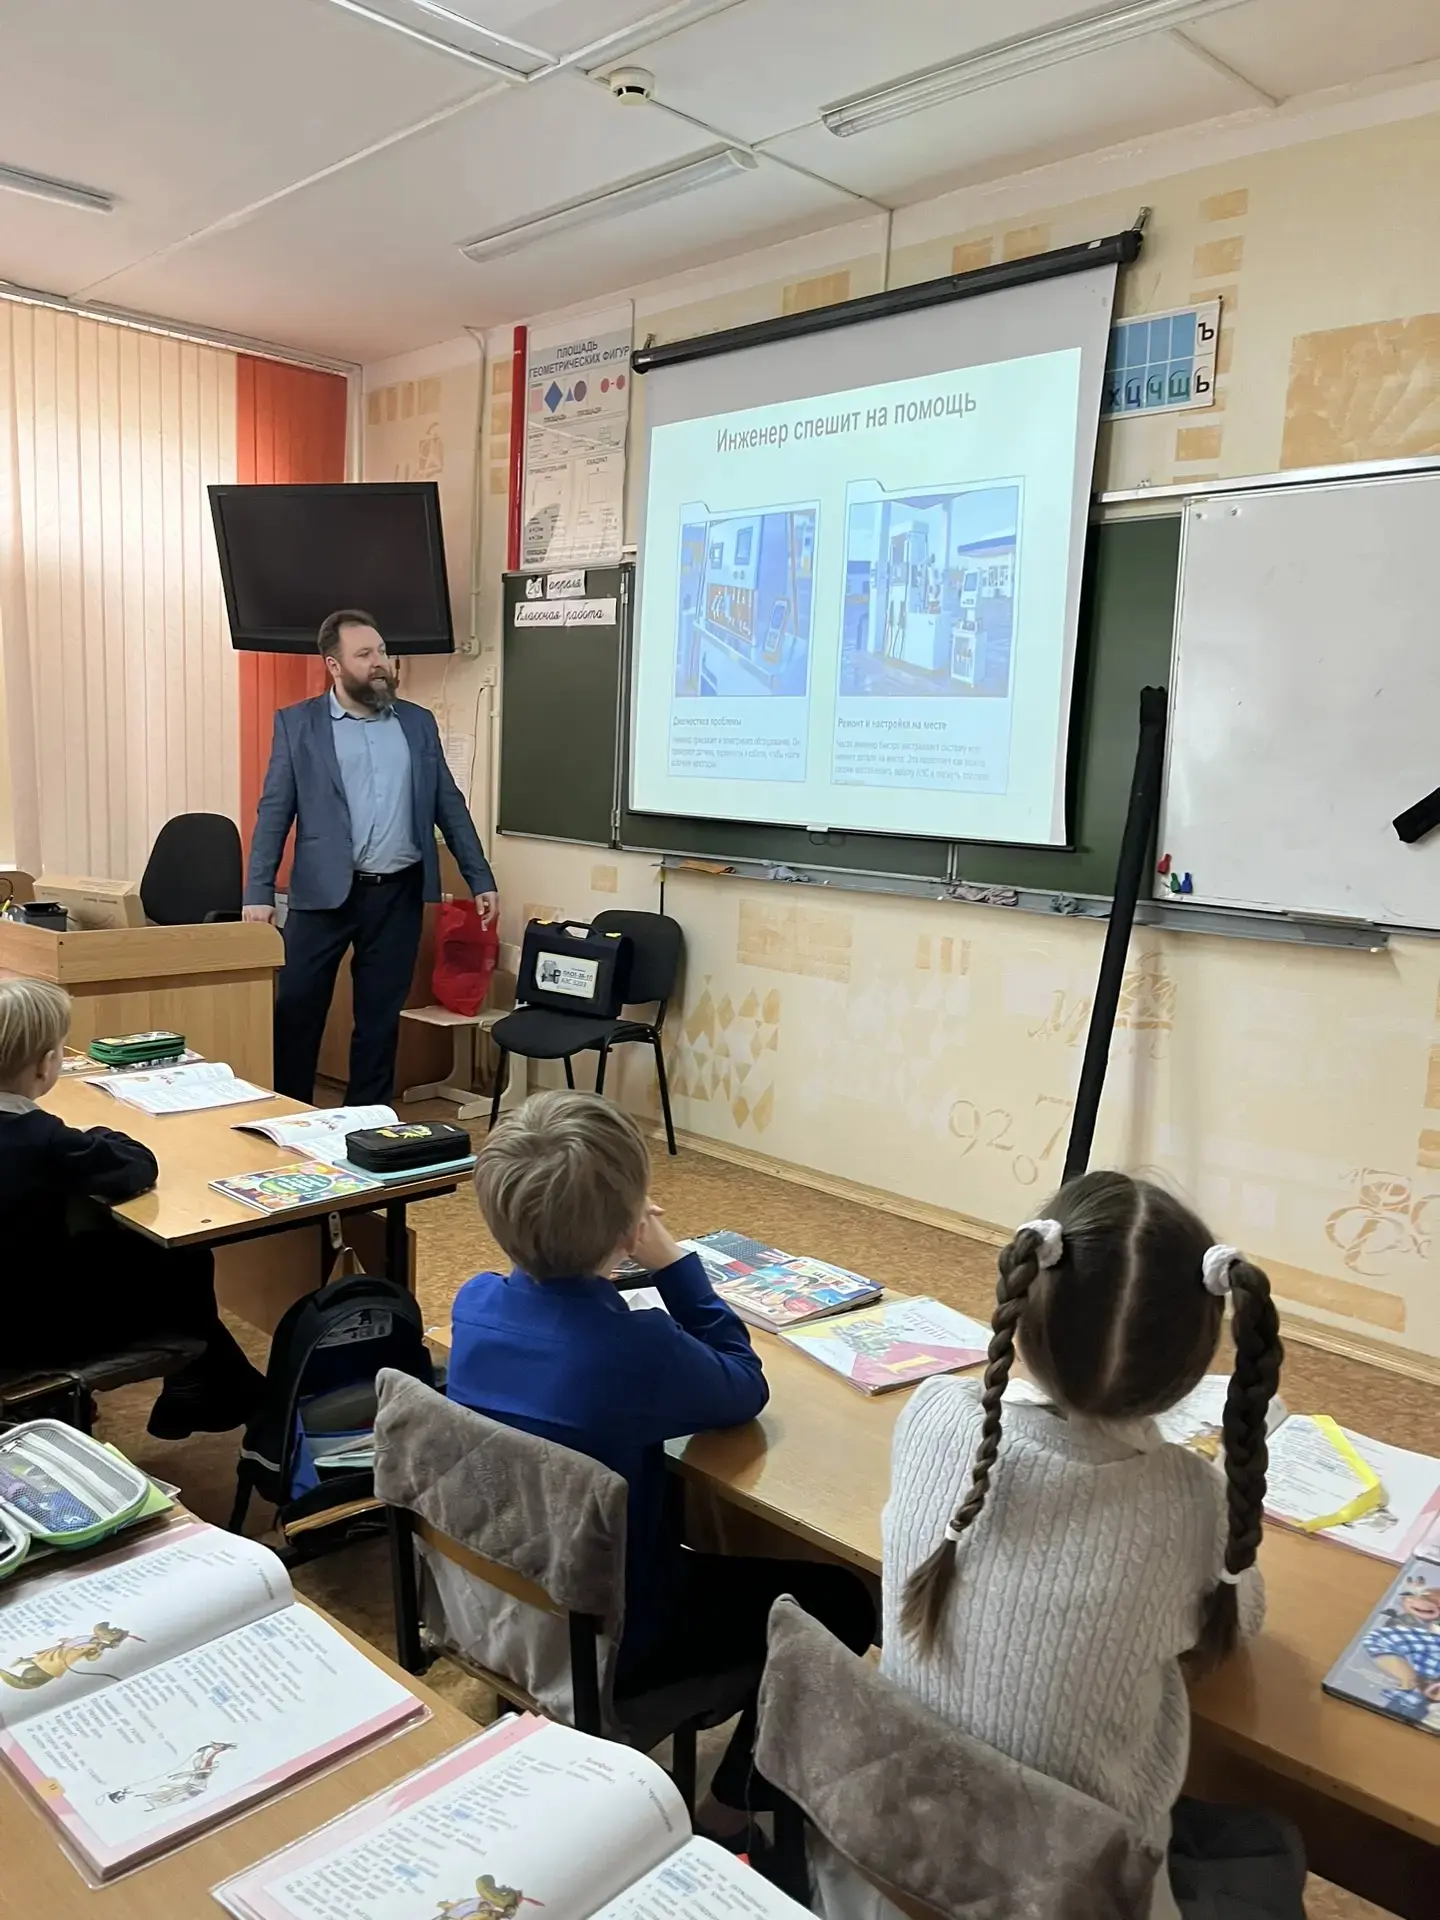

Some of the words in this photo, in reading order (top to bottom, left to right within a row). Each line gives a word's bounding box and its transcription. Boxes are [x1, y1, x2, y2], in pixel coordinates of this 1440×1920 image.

[529, 353, 601, 378] ГЕОМЕТРИЧЕСКИХ
[602, 345, 630, 361] ФИГУР
[556, 341, 598, 359] ПЛОЩАДЬ
[717, 423, 789, 454] Инженер
[794, 410, 861, 440] спешит
[866, 405, 888, 429] на
[894, 392, 977, 425] помощь
[516, 605, 562, 622] Классная
[562, 602, 604, 626] работа
[837, 717, 864, 729] Ремонт
[871, 718, 911, 732] настройка
[912, 721, 922, 730] на
[923, 721, 947, 731] месте
